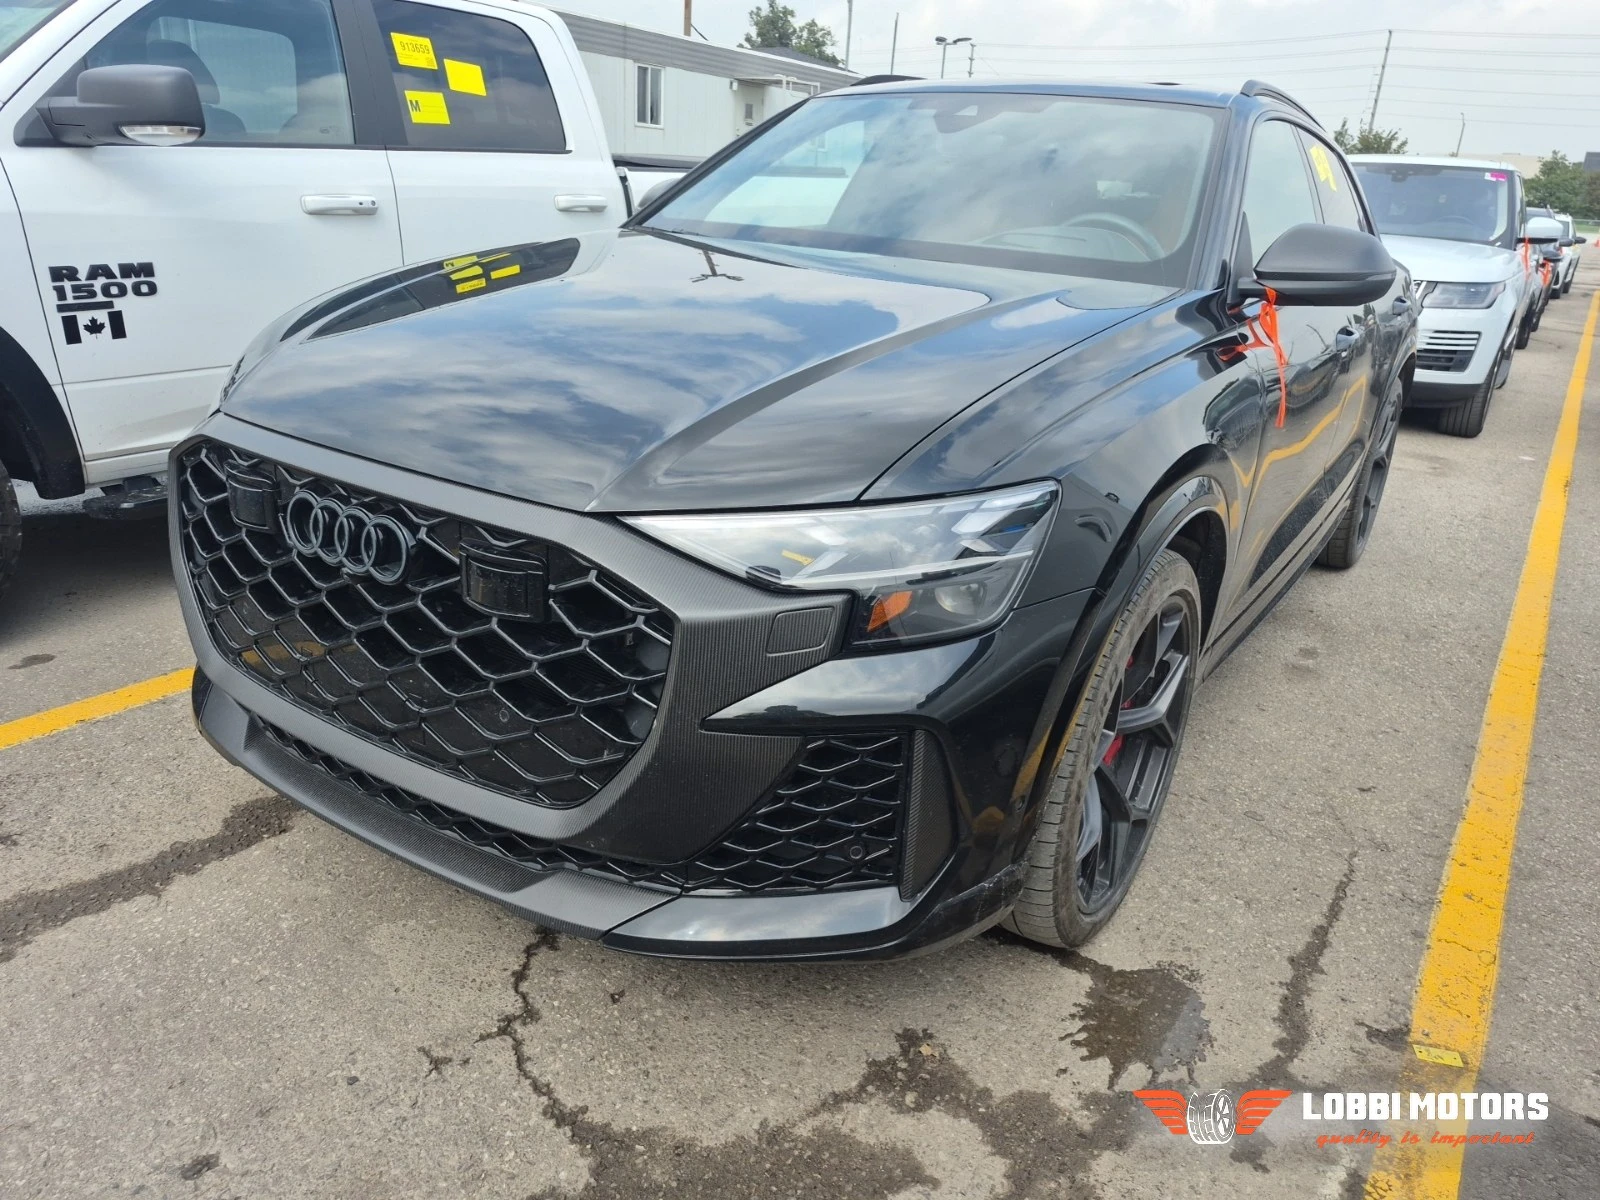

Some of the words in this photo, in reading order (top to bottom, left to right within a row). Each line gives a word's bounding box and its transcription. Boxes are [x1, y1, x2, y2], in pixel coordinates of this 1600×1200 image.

[400, 41, 431, 55] 913659
[409, 99, 422, 113] M
[48, 262, 155, 283] RAM
[52, 280, 158, 302] 1500
